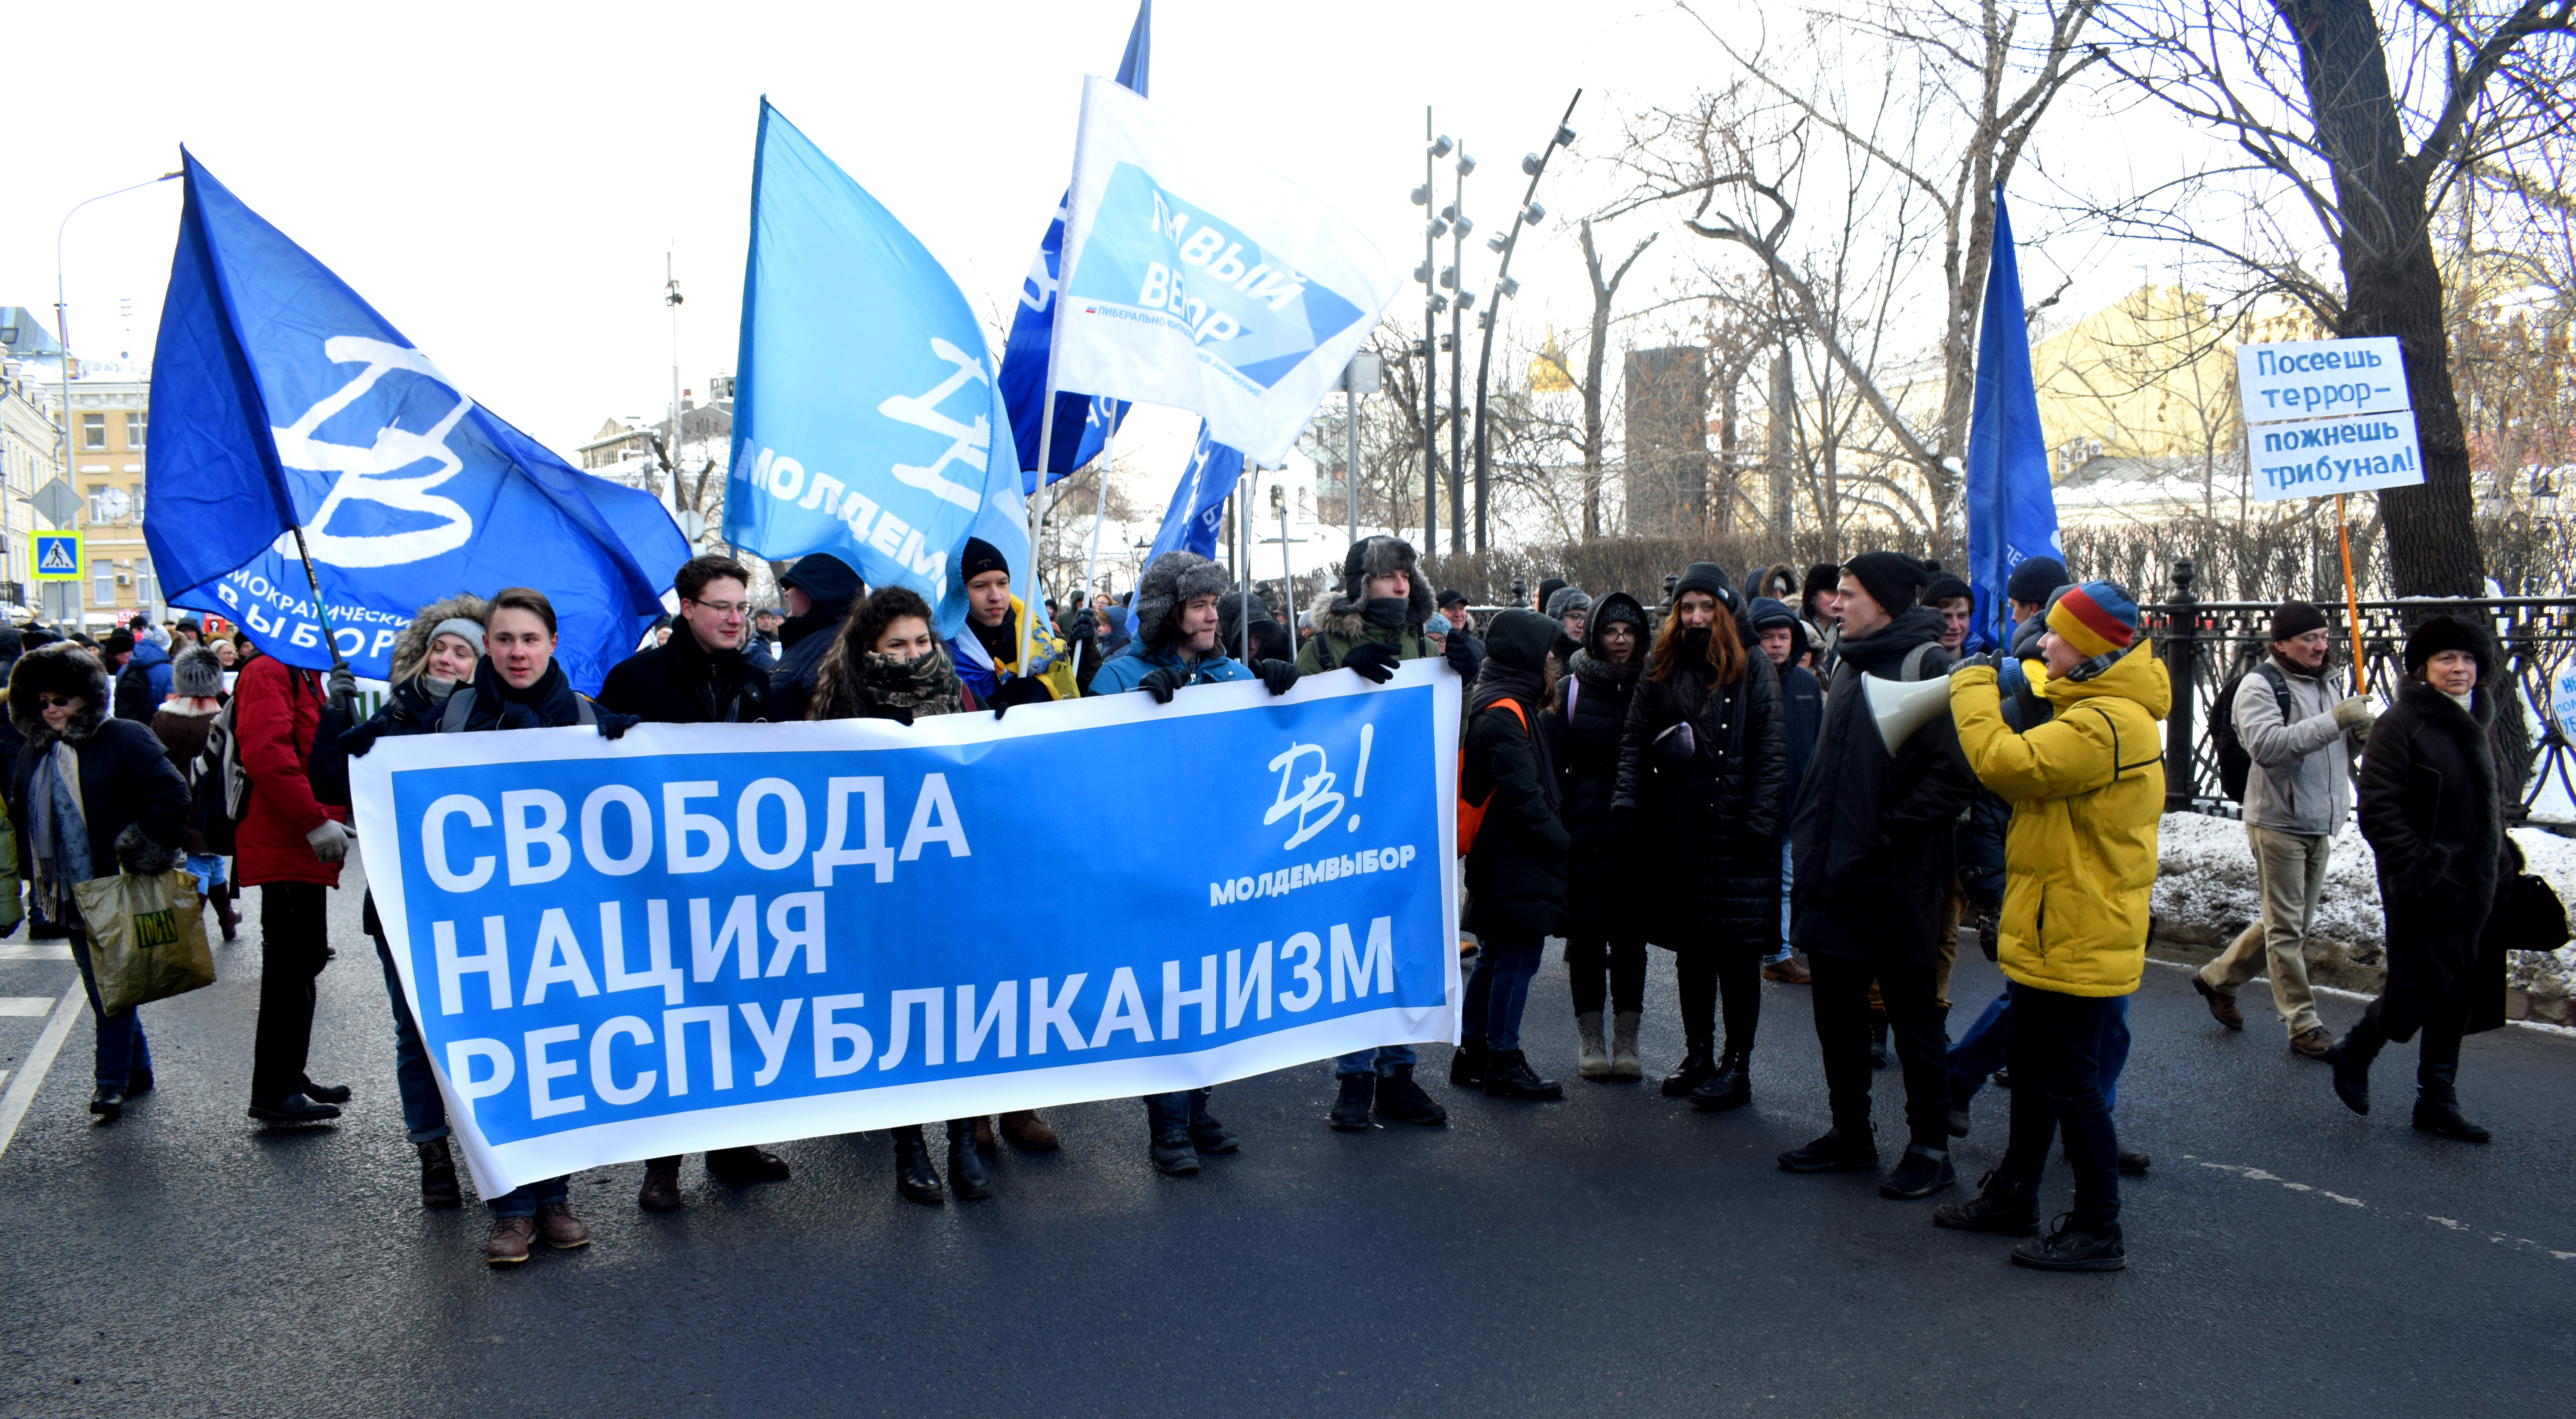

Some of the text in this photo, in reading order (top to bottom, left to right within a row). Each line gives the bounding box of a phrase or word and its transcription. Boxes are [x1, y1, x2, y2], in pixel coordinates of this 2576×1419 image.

[1212, 361, 1264, 399] ДВИЖЕНИЕ
[2257, 350, 2382, 376] Посеешь
[2261, 446, 2415, 490] трибунал!
[218, 582, 398, 658] ВЫБОР
[422, 773, 971, 893] СВОБОДА
[1210, 844, 1415, 907] МОЛДЕМВЫБОР
[433, 892, 826, 1016] НАЦИЯ
[447, 916, 1394, 1121] РЕСПУБЛИКАНИЗМ
